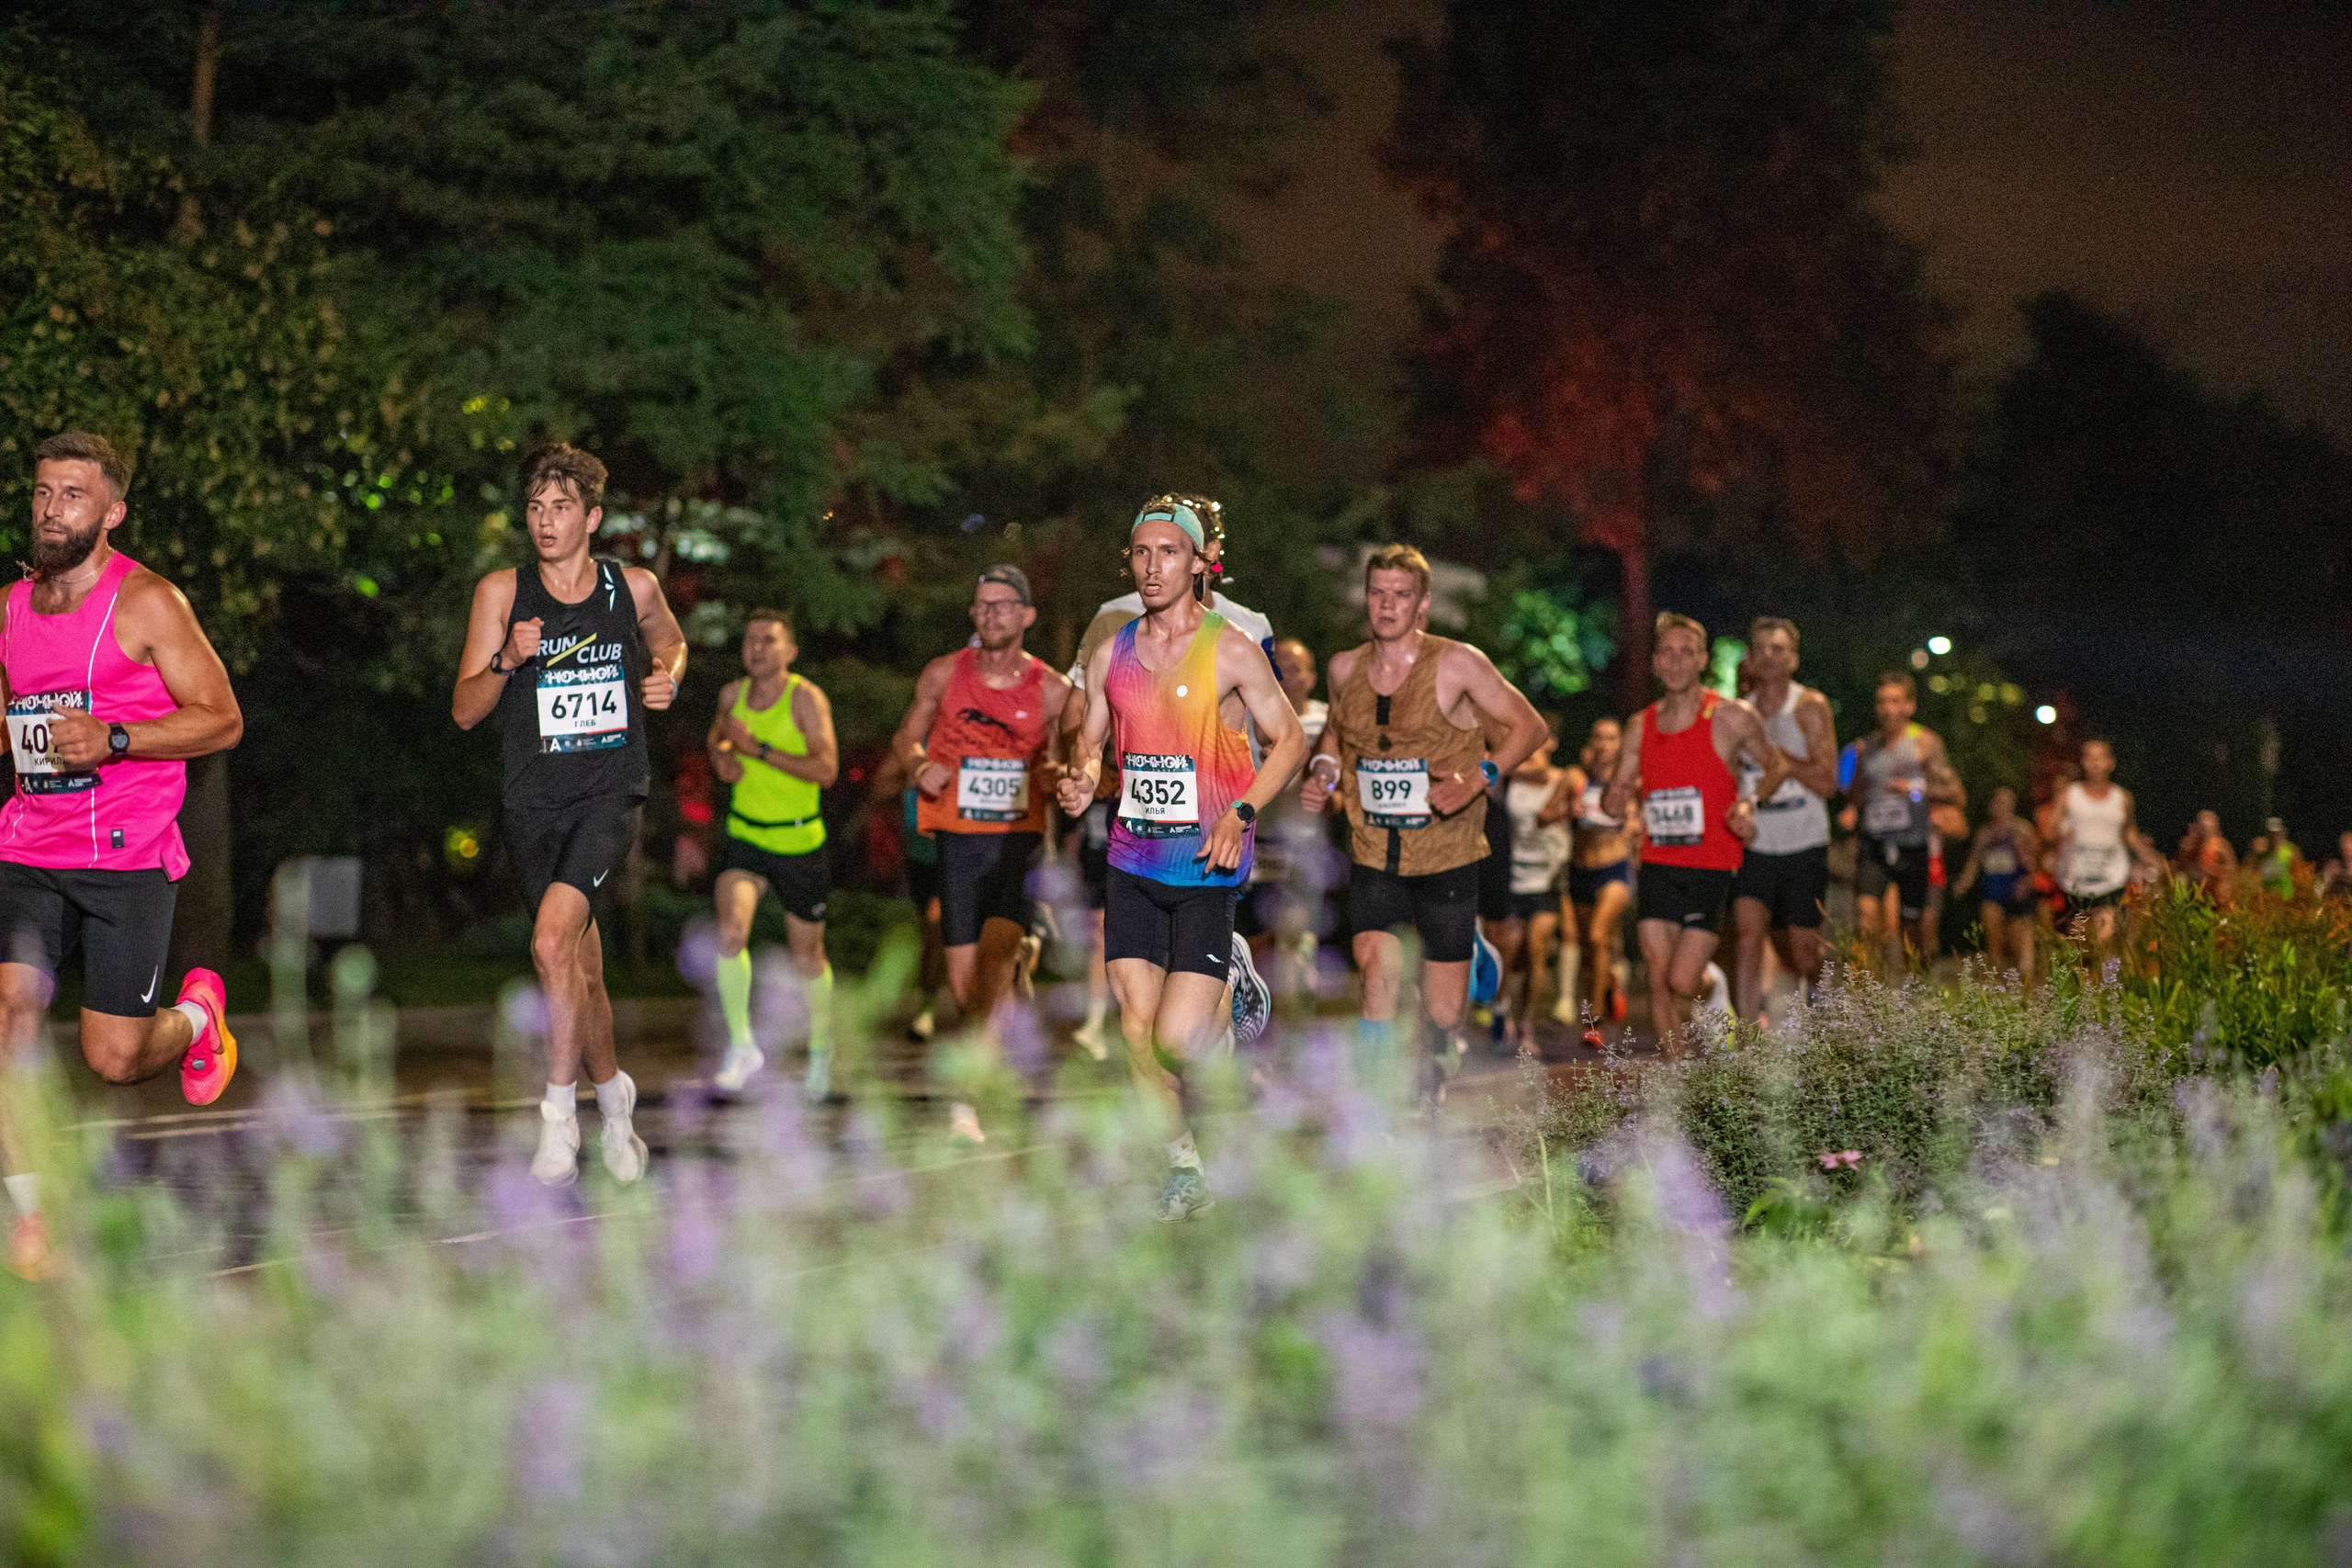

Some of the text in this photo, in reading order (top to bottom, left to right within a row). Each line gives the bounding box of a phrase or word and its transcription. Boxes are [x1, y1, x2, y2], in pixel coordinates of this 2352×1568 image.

[537, 636, 577, 656] RUN
[576, 643, 622, 664] CLUB
[551, 690, 616, 719] 6714
[574, 719, 596, 728] ГЛЕБ
[21, 724, 60, 754] 40
[33, 757, 66, 766] КИРИЛ
[967, 777, 1021, 797] 4305
[1131, 778, 1186, 806] 4352
[1371, 780, 1411, 800] 899
[1145, 807, 1165, 815] ИЛЬЯ
